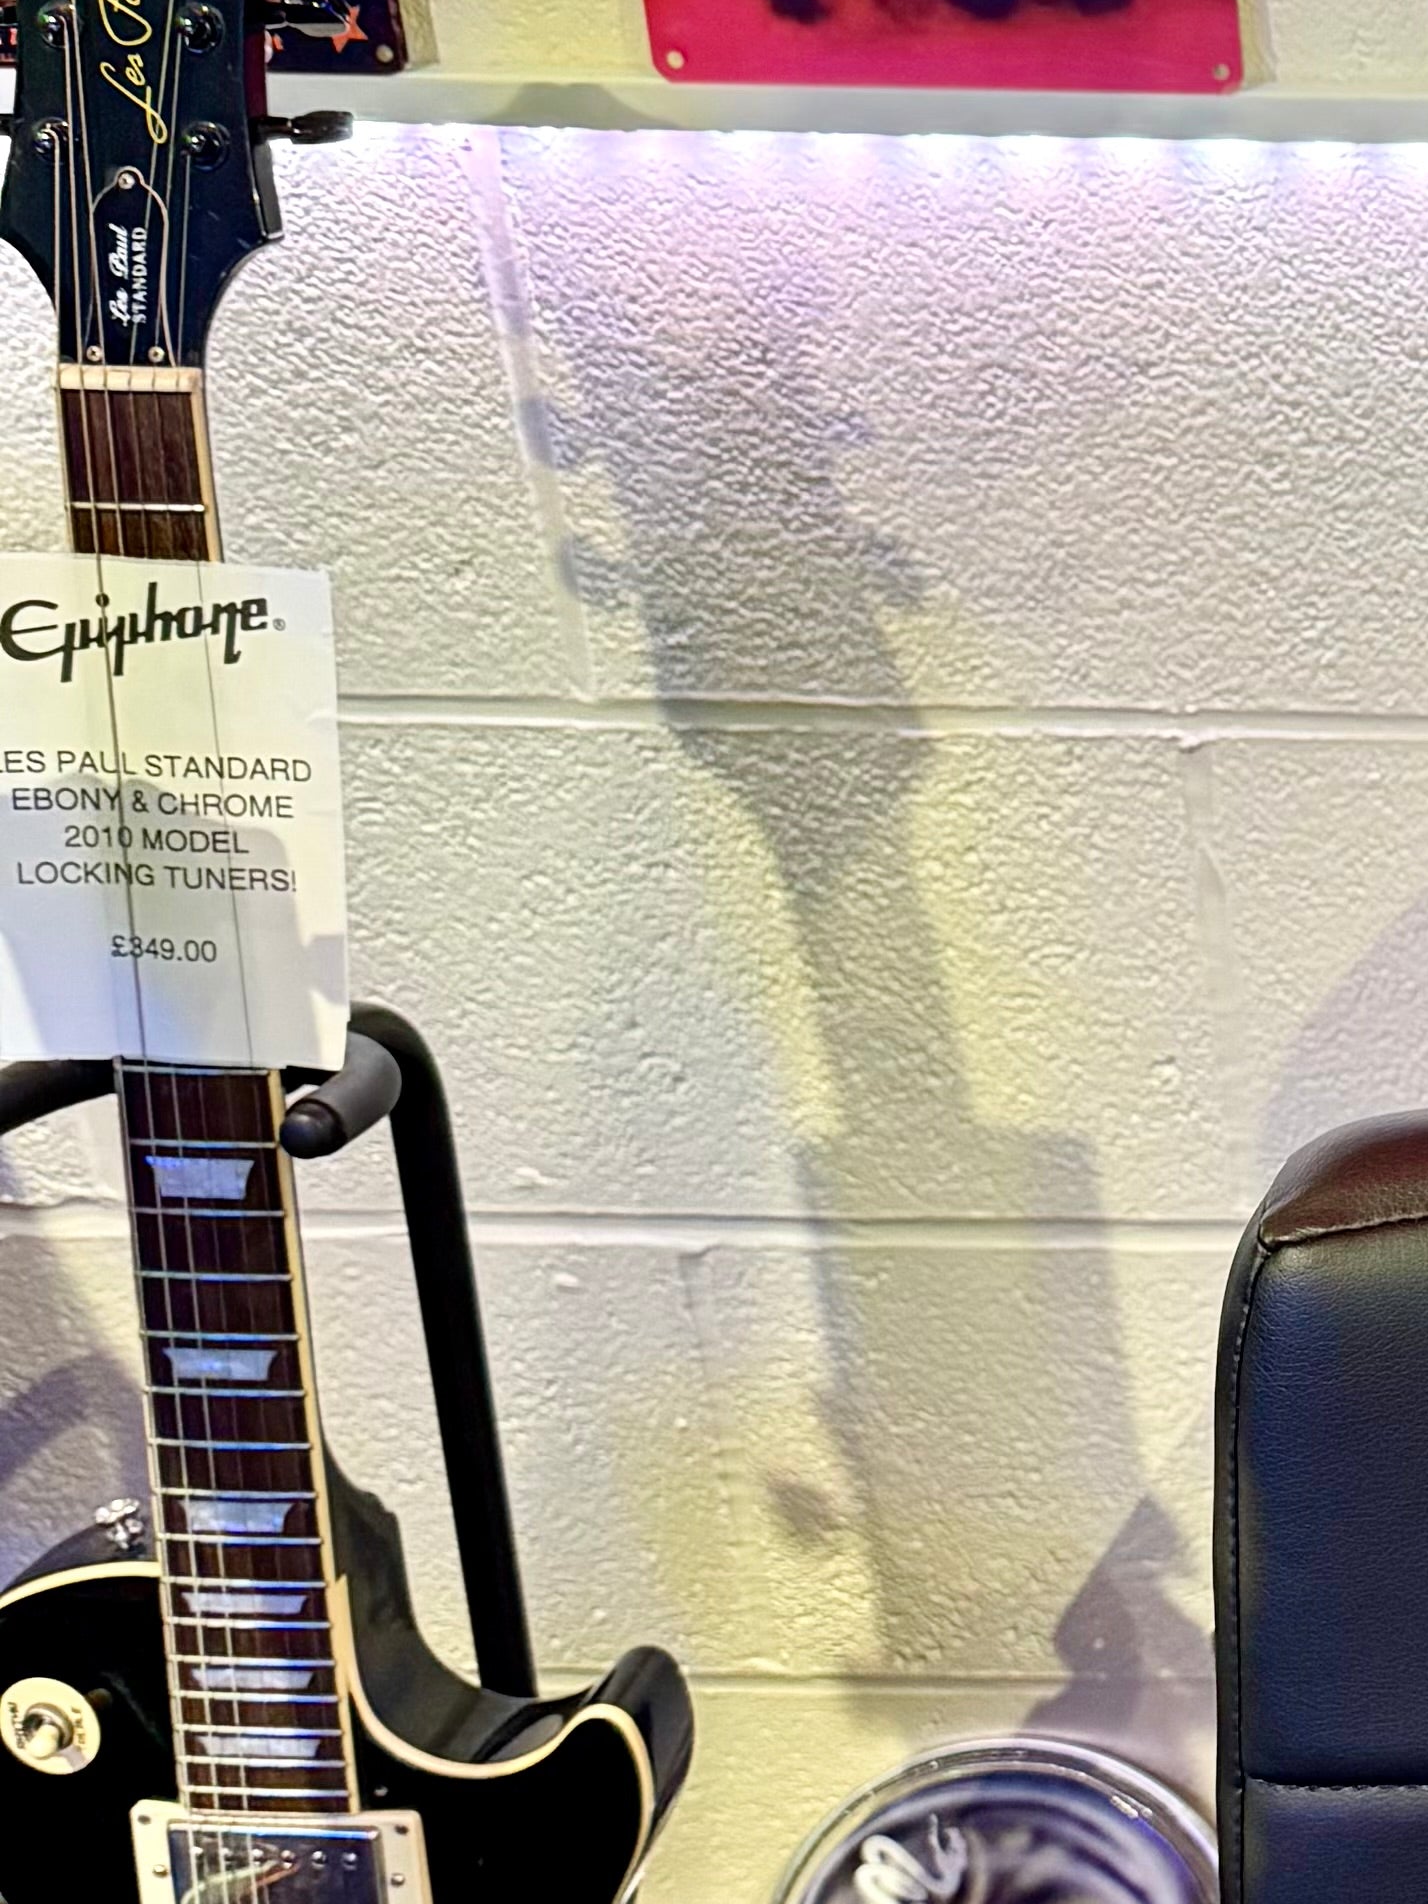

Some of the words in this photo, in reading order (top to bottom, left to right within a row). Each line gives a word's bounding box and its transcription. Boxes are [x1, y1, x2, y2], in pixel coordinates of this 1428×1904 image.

[100, 56, 168, 145] Les
[131, 225, 148, 326] STANDARD
[0, 581, 269, 683] Epiphone
[57, 750, 137, 776] PAUL
[145, 754, 313, 783] STANDARD
[12, 787, 121, 811] EBONY
[131, 790, 150, 814] &
[157, 793, 295, 819] CHROME
[64, 825, 133, 848] 2010
[142, 827, 250, 854] MODEL
[17, 861, 155, 886] LOCKING
[164, 865, 298, 893] TUNERS!
